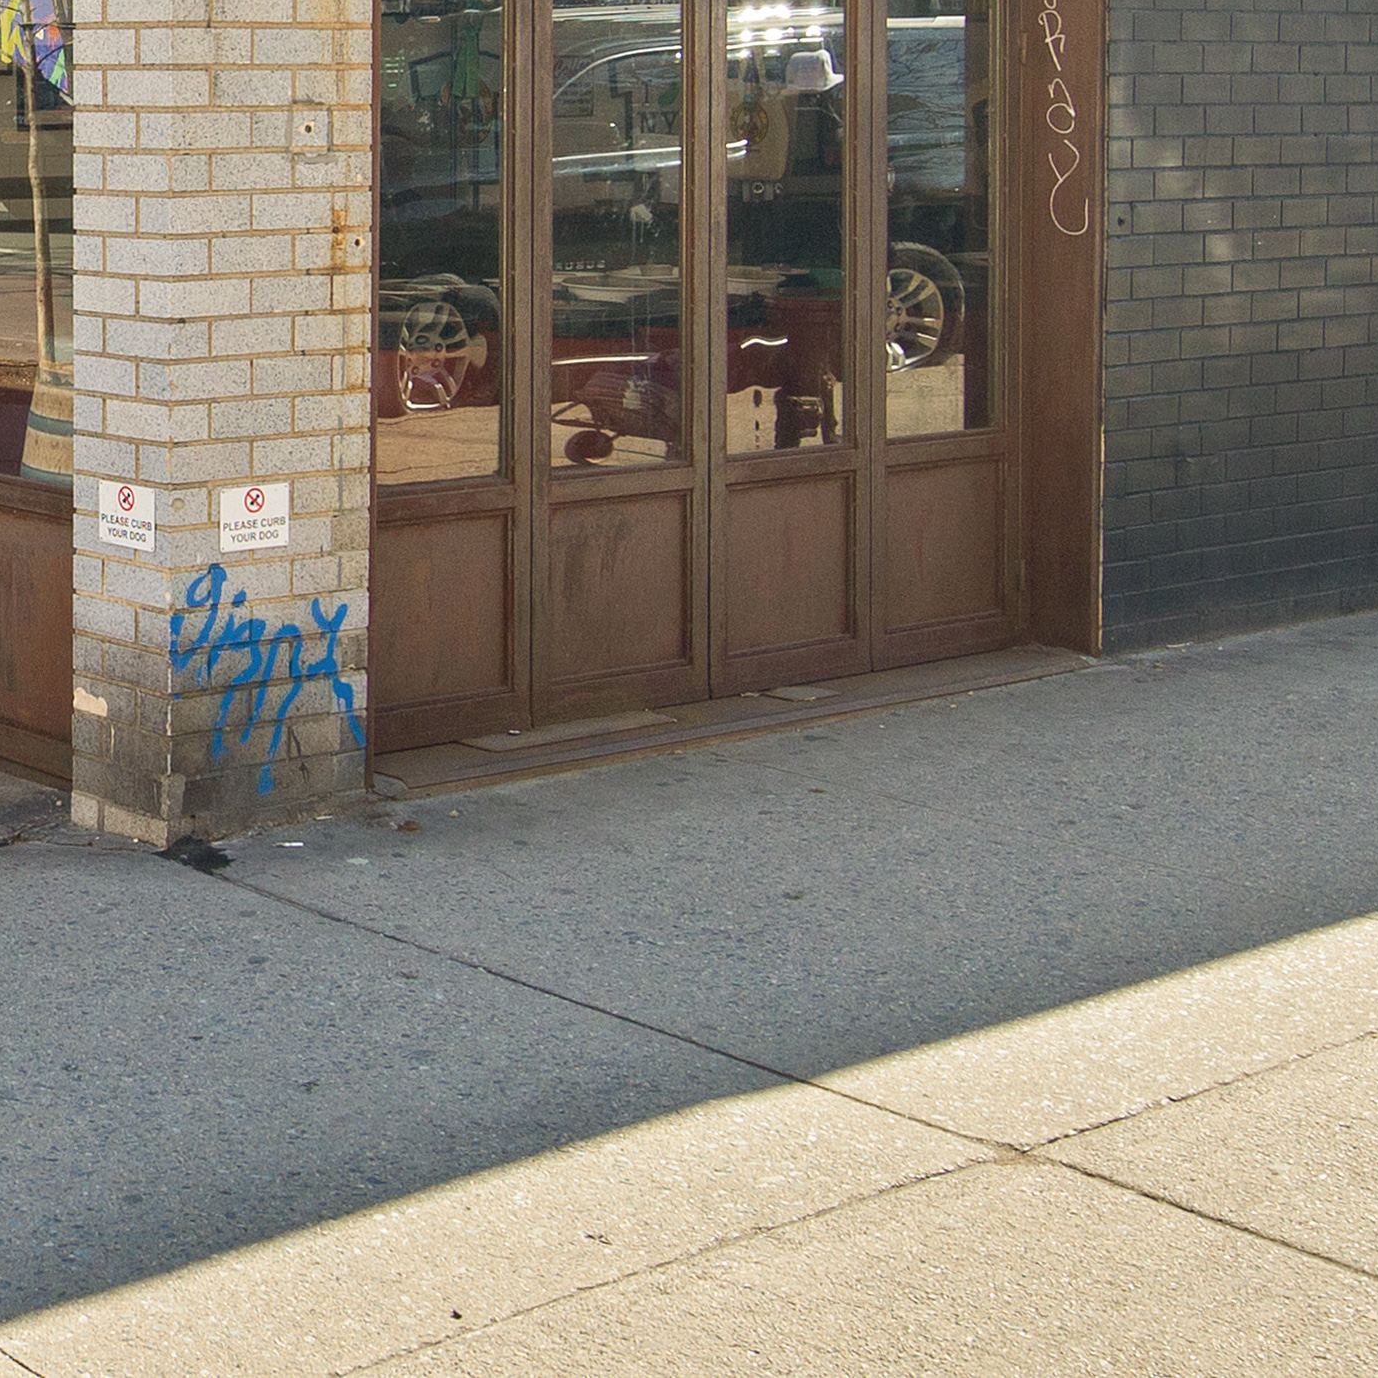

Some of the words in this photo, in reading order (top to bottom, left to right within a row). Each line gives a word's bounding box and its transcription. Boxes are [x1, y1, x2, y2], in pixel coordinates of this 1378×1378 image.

[101, 513, 129, 526] PLEASE
[130, 519, 152, 532] CURB
[223, 519, 258, 532] PLEASE
[260, 516, 286, 527] CURB
[107, 526, 128, 539] YOUR
[129, 530, 147, 543] DOG
[230, 531, 257, 543] YOUR
[259, 529, 279, 540] DOG
